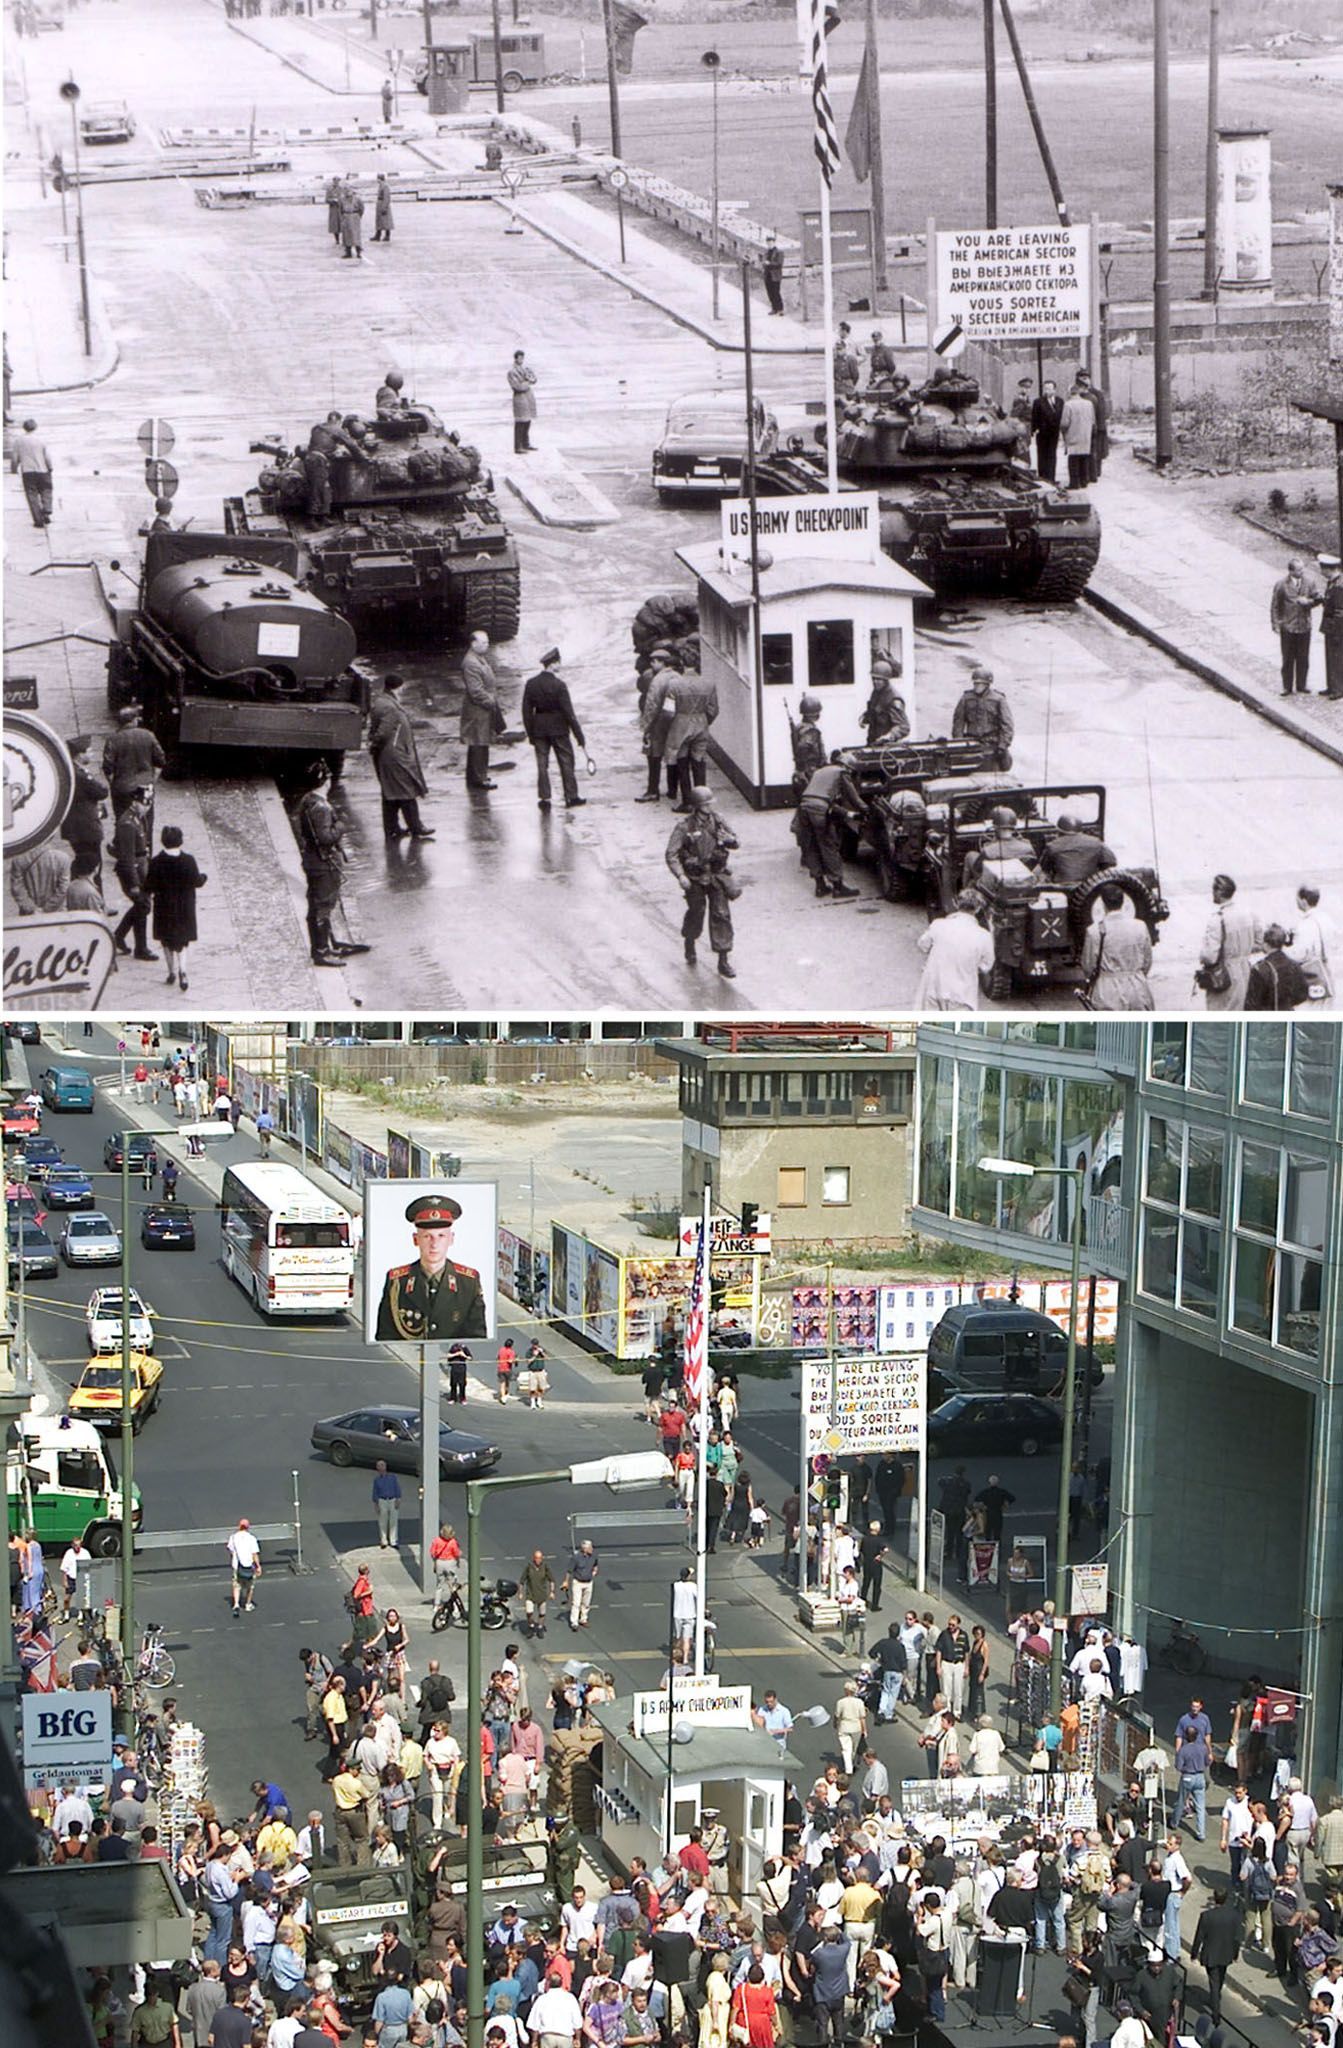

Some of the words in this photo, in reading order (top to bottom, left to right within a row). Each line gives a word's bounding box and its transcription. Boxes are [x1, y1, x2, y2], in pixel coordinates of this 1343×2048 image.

[955, 235, 981, 248] YOU
[987, 234, 1012, 247] ARE
[1019, 232, 1070, 245] LEAVING
[950, 250, 968, 262] THE
[974, 248, 1030, 261] AMERICAN
[1035, 246, 1077, 259] SECTOR
[951, 267, 971, 280] ВЫ
[977, 264, 1051, 278] ВЫЕЗЖАЕТЕ
[1059, 263, 1075, 276] ИЗ
[1035, 278, 1078, 291] СЕКТОРА
[969, 297, 1003, 310] VOUS
[1010, 296, 1057, 310] SORTEZ
[969, 312, 1016, 326] SECTEUR
[1021, 310, 1080, 323] AMERICAIN
[754, 510, 789, 534] ARMY
[795, 506, 869, 533] CHECKPOINT
[844, 1364, 863, 1374] ARE
[870, 1361, 914, 1373] LEAVING
[811, 1378, 827, 1388] THE
[838, 1375, 880, 1387] MERICAN
[884, 1373, 920, 1385] SECTOR
[861, 1412, 901, 1424] SORTEZ
[809, 1429, 822, 1439] DU
[688, 1695, 744, 1713] CHECKPOINT
[37, 1709, 97, 1738] BfG
[32, 1768, 103, 1779] Geldautomat
